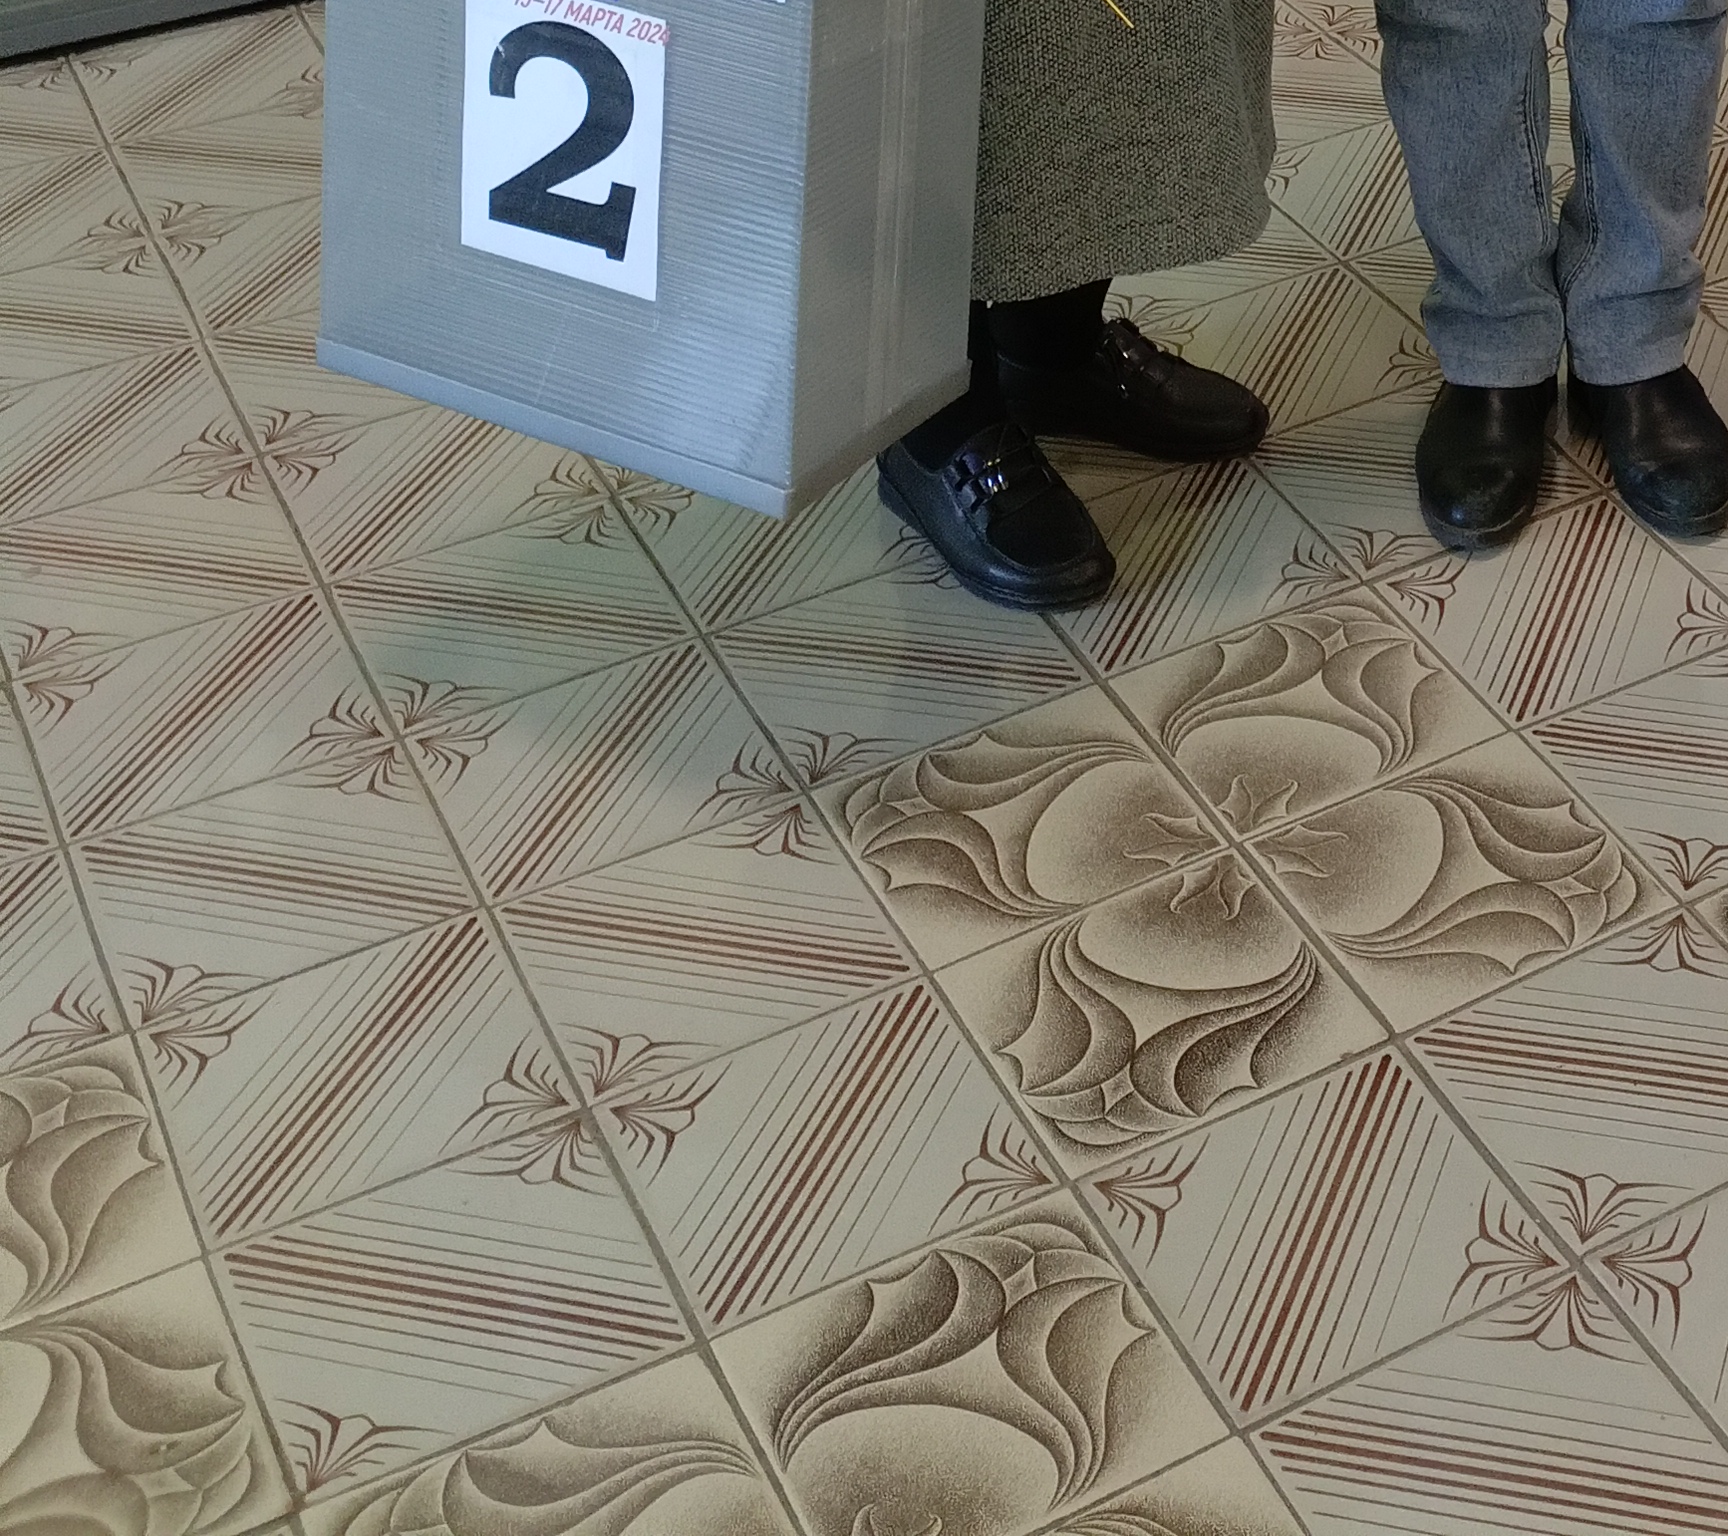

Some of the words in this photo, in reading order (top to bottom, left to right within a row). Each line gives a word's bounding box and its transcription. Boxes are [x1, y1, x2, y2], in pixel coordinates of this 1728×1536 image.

[564, 0, 624, 34] МАРТА
[626, 17, 671, 46] 2024
[488, 19, 636, 262] 2
